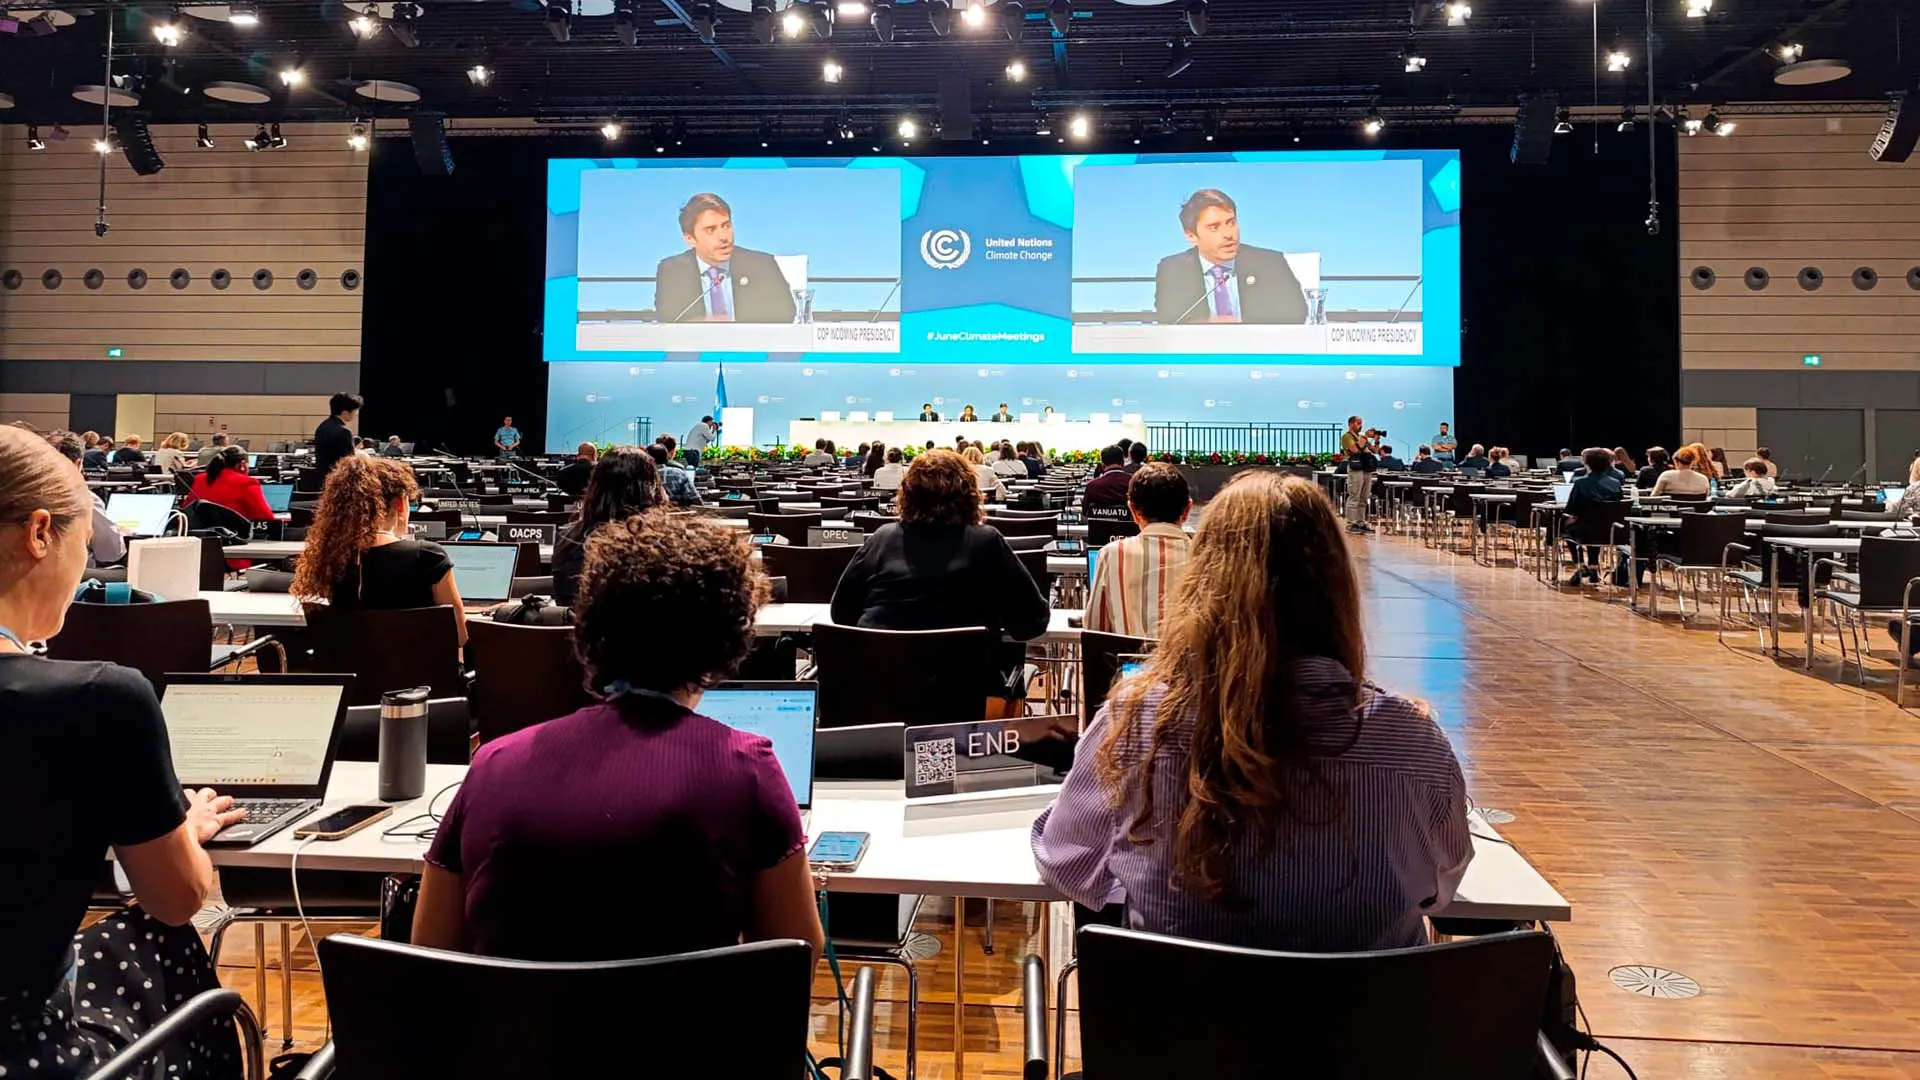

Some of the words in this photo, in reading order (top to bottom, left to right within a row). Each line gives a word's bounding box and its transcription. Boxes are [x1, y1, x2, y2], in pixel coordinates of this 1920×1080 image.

[985, 238, 1015, 247] United
[1018, 238, 1053, 247] Nations
[985, 250, 1018, 260] Climate
[1020, 250, 1053, 261] Change
[830, 327, 858, 341] INCOMING
[859, 327, 896, 342] PRESIDENCY
[927, 331, 1045, 343] #JuneClimateMeetings
[1331, 328, 1345, 342] COP
[1346, 328, 1376, 342] INCOMING
[1377, 328, 1417, 343] PRESIDENCY
[1092, 508, 1128, 517] VANUATU
[509, 528, 542, 539] OACPS
[822, 530, 849, 540] OPEC
[968, 730, 1020, 757] ENB
